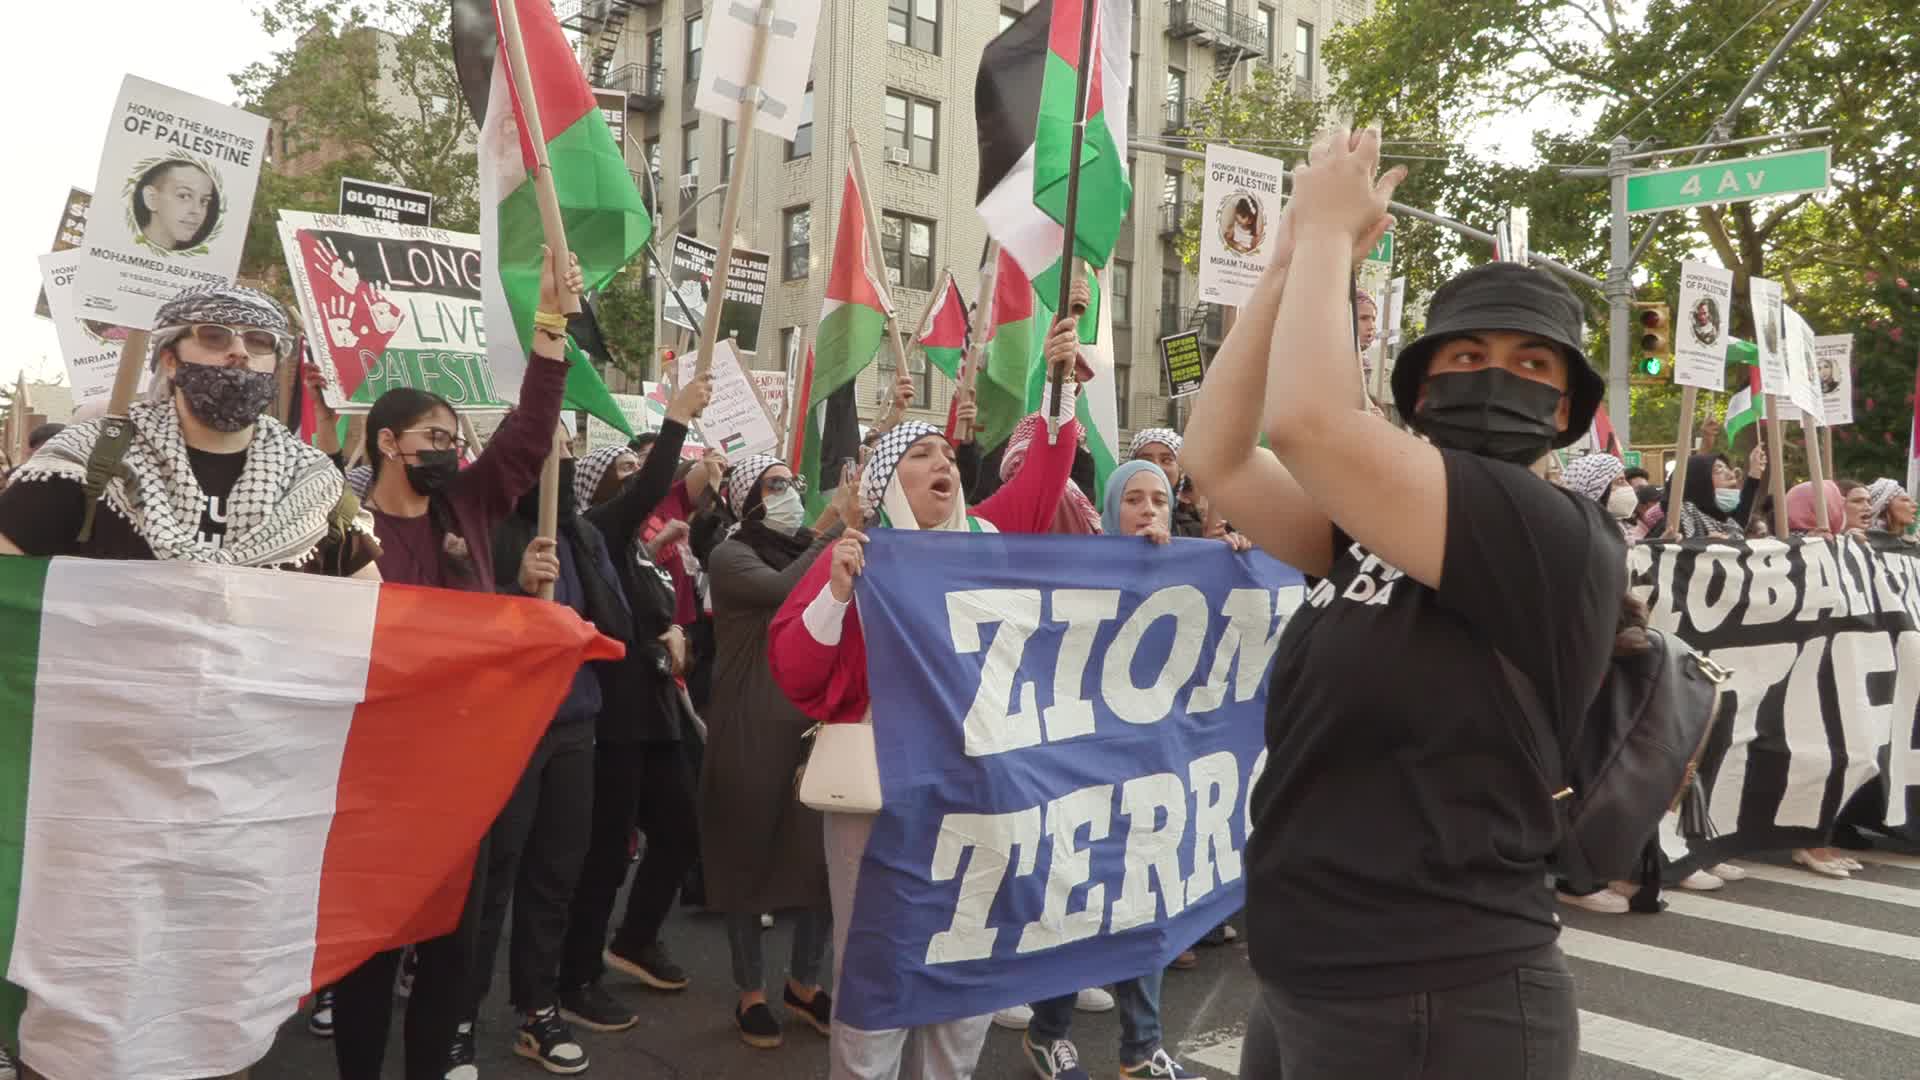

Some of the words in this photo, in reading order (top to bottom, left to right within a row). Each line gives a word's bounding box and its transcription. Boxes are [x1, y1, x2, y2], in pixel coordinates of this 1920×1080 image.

[127, 102, 174, 125] HONOR
[178, 116, 202, 133] THE
[203, 125, 254, 150] MARTYRS
[124, 116, 152, 135] OF
[155, 125, 251, 167] PALESTINE
[1211, 162, 1236, 172] HONOR
[1238, 167, 1249, 175] THE
[1250, 169, 1277, 182] MARTYRS
[1211, 170, 1226, 182] OF
[1227, 173, 1277, 194] PALESTINE
[1680, 174, 1701, 197] 4
[346, 190, 426, 215] GLOBALIZE
[373, 207, 399, 221] THE
[89, 247, 164, 271] MOHAMMED
[165, 264, 187, 277] ABU
[376, 241, 481, 291] LONG
[691, 254, 706, 265] THE
[748, 260, 768, 271] FREE
[1209, 256, 1237, 267] MIRIAM
[54, 274, 74, 286] OF
[727, 266, 767, 282] LESTINE
[746, 281, 765, 293] OUR
[1686, 281, 1696, 289] OF
[1697, 282, 1728, 298] PALESTINE
[408, 298, 487, 348] LIVE
[73, 351, 118, 367] MIRIAM
[945, 584, 1304, 757] ZION
[924, 747, 1268, 965] TERR
